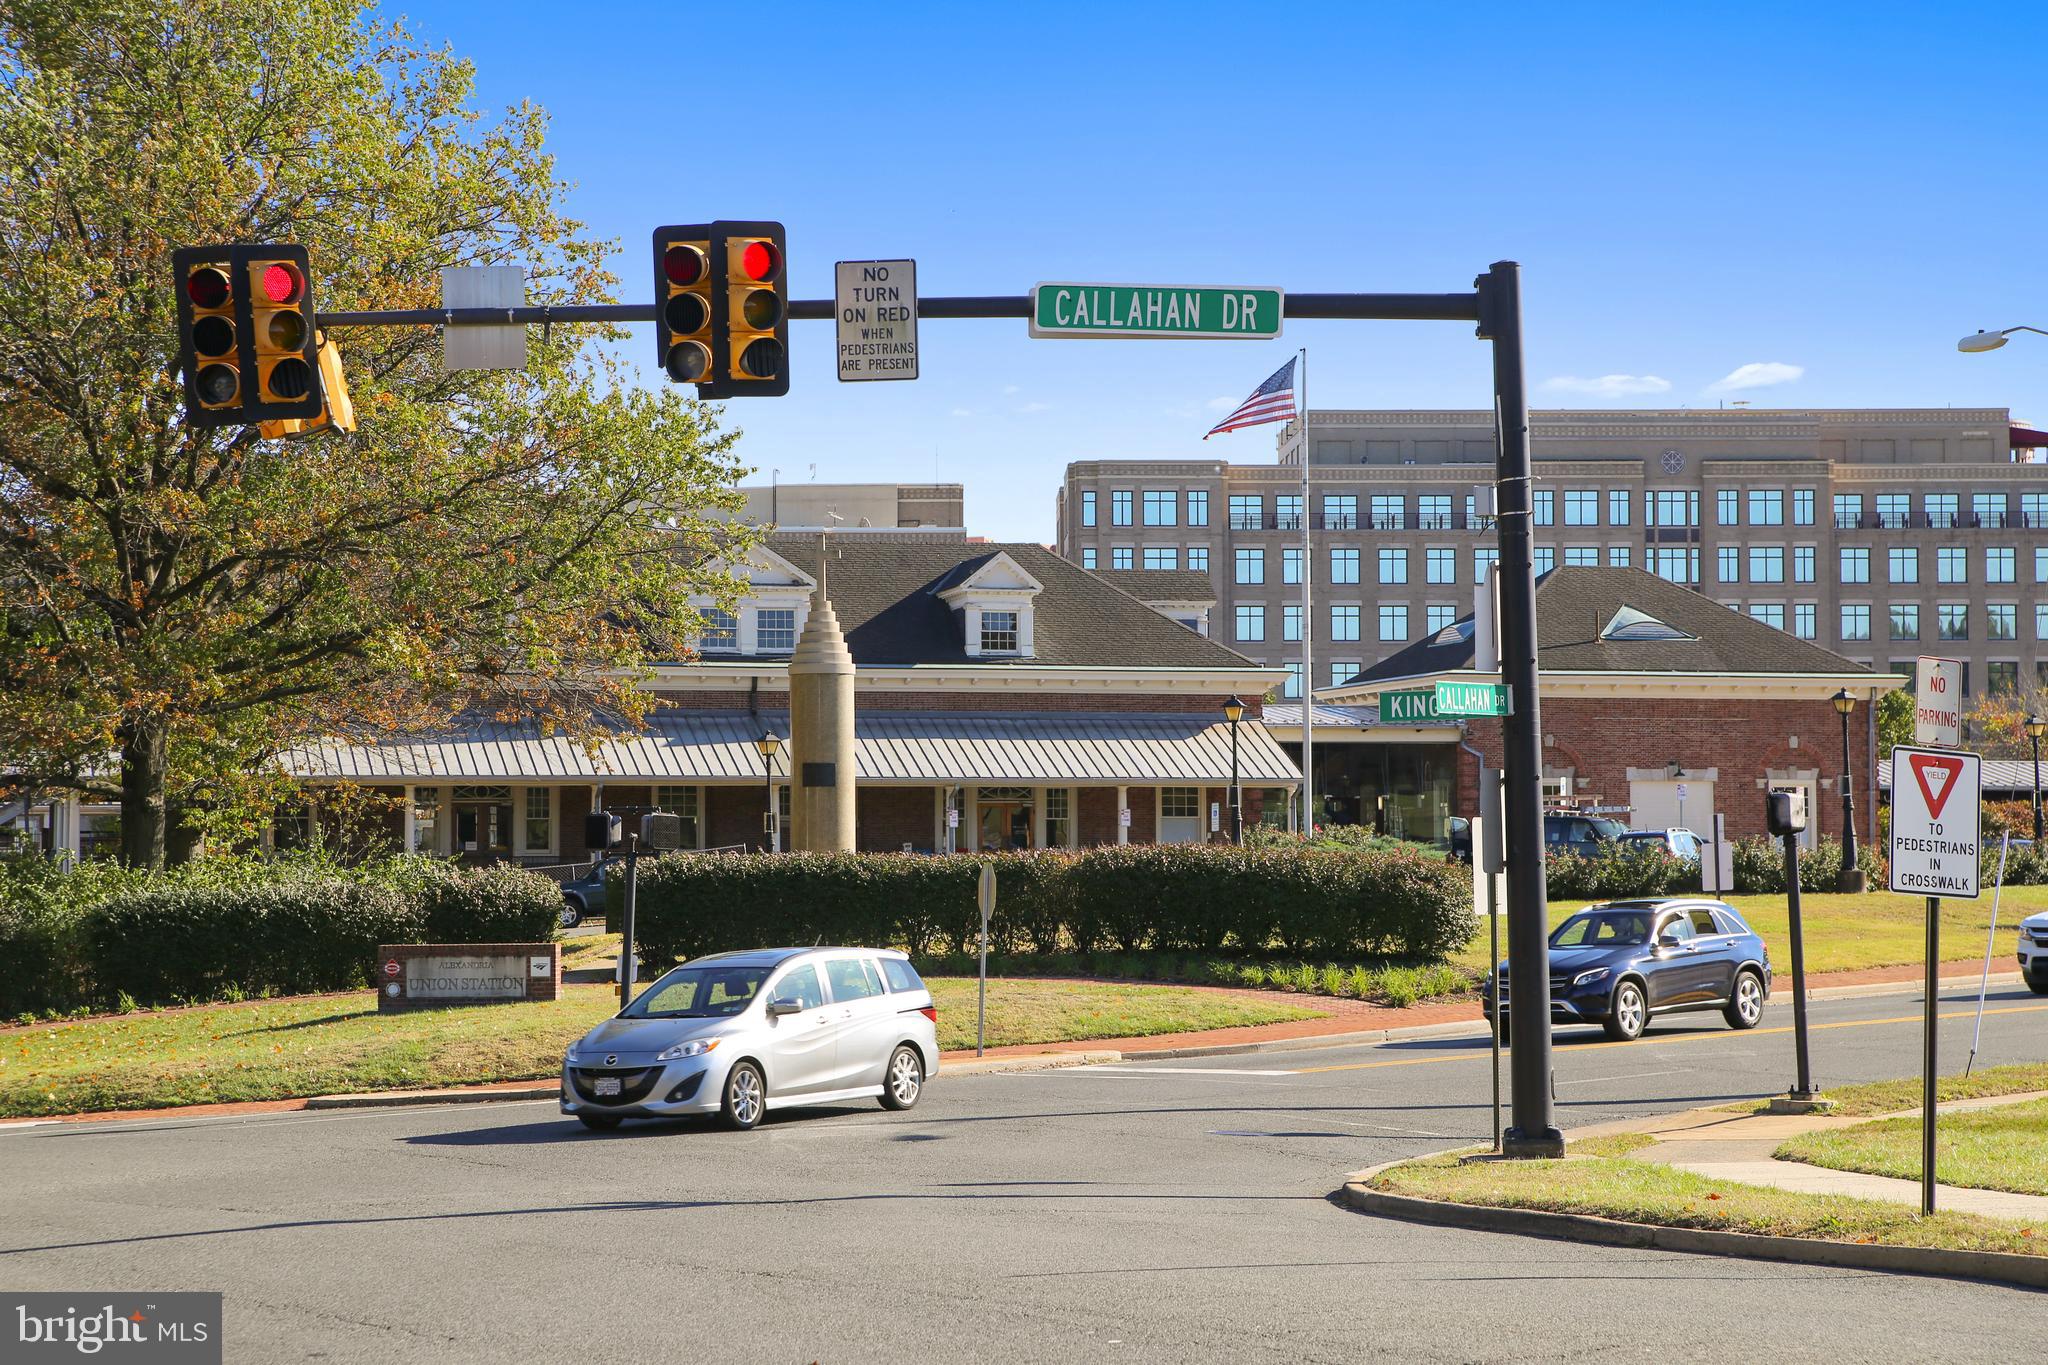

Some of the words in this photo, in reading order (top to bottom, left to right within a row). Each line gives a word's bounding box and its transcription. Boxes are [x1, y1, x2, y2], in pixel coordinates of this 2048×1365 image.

[864, 267, 889, 281] NO
[853, 287, 899, 302] TURN
[843, 308, 866, 323] ON
[877, 307, 910, 322] RED
[1055, 289, 1200, 329] CALLAHAN
[1222, 293, 1258, 330] DR
[861, 327, 893, 340] WHEN
[840, 342, 914, 356] PEDESTRIANS
[841, 359, 861, 371] ARE
[868, 358, 915, 370] PRESENT
[1930, 676, 1946, 693] NO
[1438, 686, 1491, 711] CALLAHAN
[1494, 695, 1505, 706] DR
[1391, 695, 1440, 718] KING
[1918, 708, 1957, 728] PARKING
[1926, 770, 1947, 780] YIELD
[1929, 822, 1943, 836] TO
[1896, 837, 1975, 856] PEDESTRIANS
[1929, 857, 1941, 870] IN
[1901, 873, 1969, 891] CROSSWALK
[438, 961, 495, 969] ALEXANDRIA
[408, 978, 460, 991] UNION
[461, 976, 525, 991] STATION
